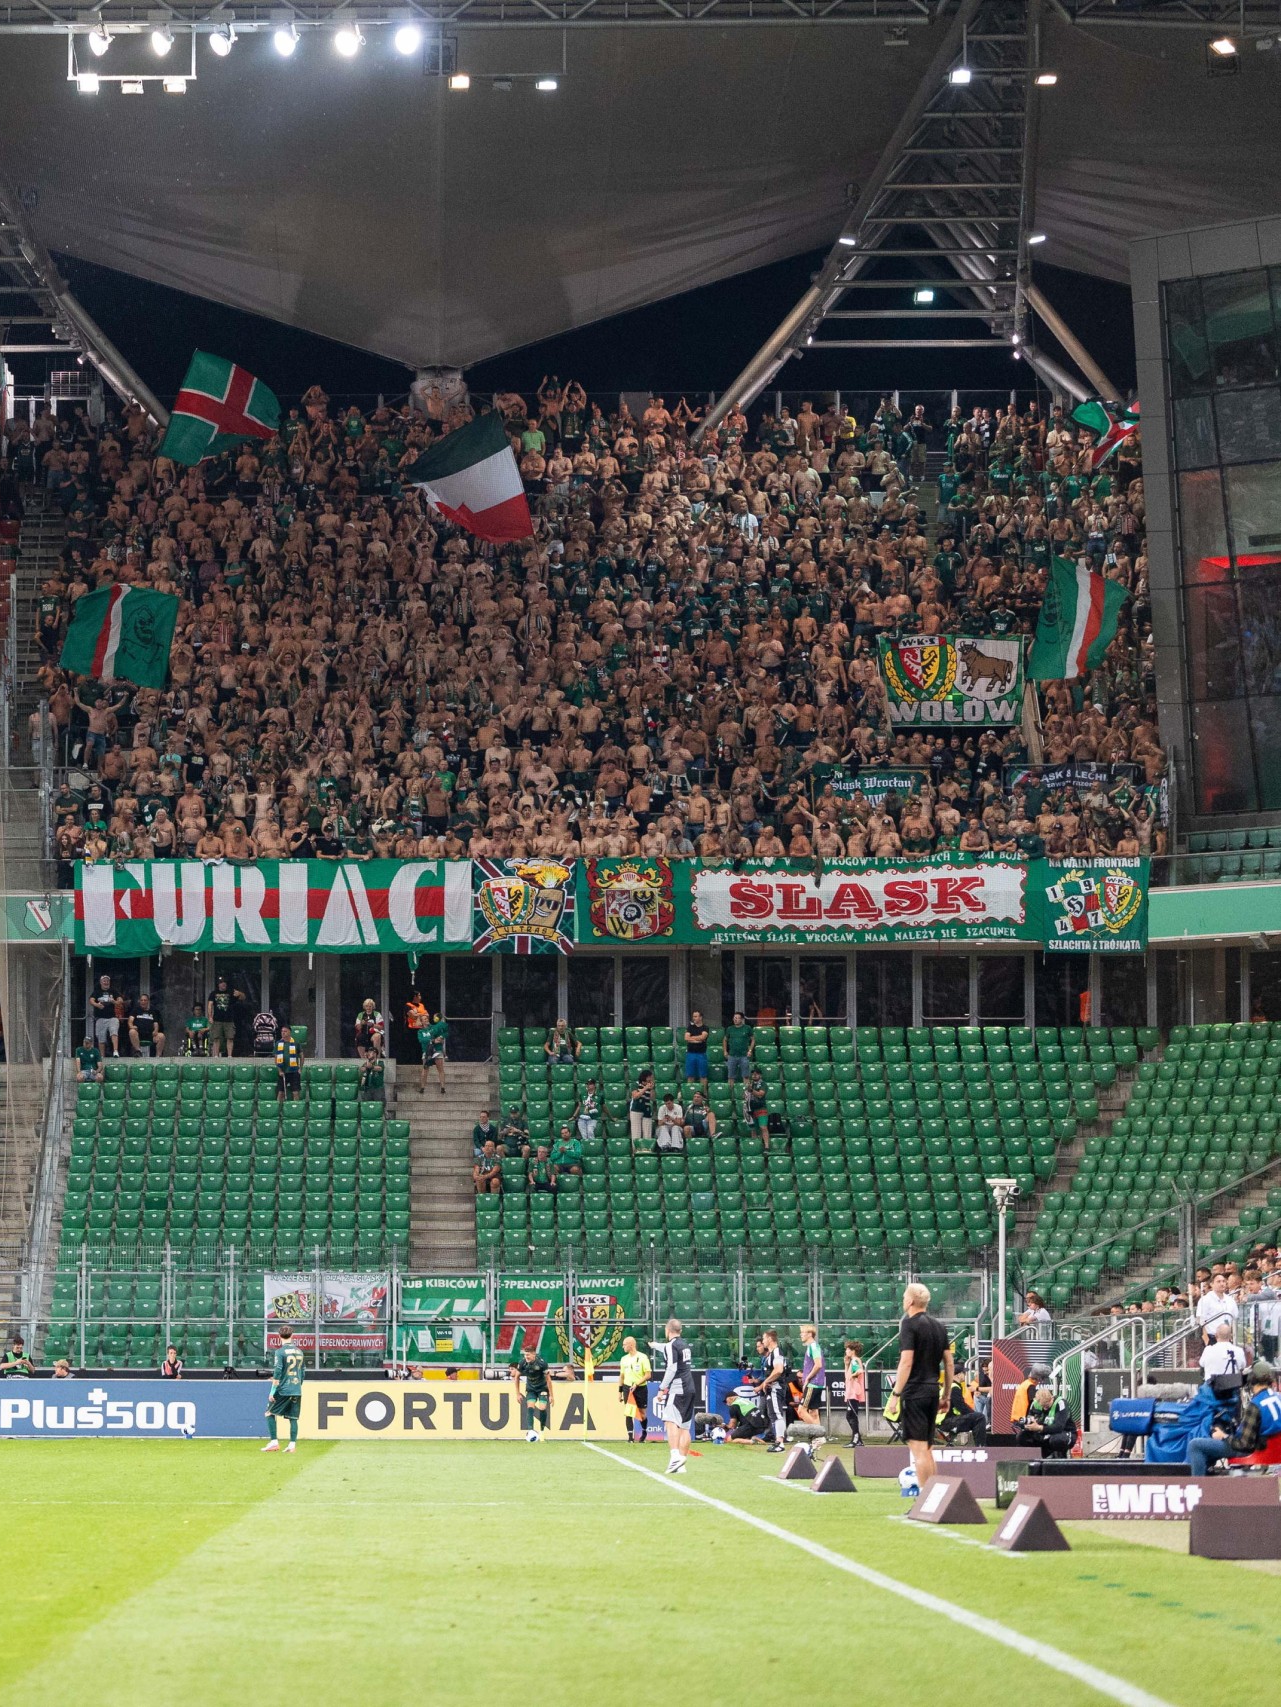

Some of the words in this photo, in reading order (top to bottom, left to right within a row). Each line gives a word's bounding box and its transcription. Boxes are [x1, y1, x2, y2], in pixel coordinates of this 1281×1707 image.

[888, 697, 1019, 722] WOŁÓW
[1094, 857, 1140, 868] FRONTACH
[729, 876, 986, 922] ŚLĄSK
[504, 925, 548, 934] ULTRAS
[864, 932, 888, 942] NAM
[894, 929, 936, 941] NALEŻY
[966, 926, 1017, 937] SZACUNEK
[1092, 940, 1098, 950] Z
[1100, 939, 1141, 951] TRÓJKĄTA
[401, 1280, 423, 1289] LUB
[318, 1337, 384, 1348] IEPEŁNOSPRAWNYCH
[286, 1355, 304, 1376] 27
[0, 1398, 197, 1429] Plus500
[1105, 1484, 1203, 1513] Witt
